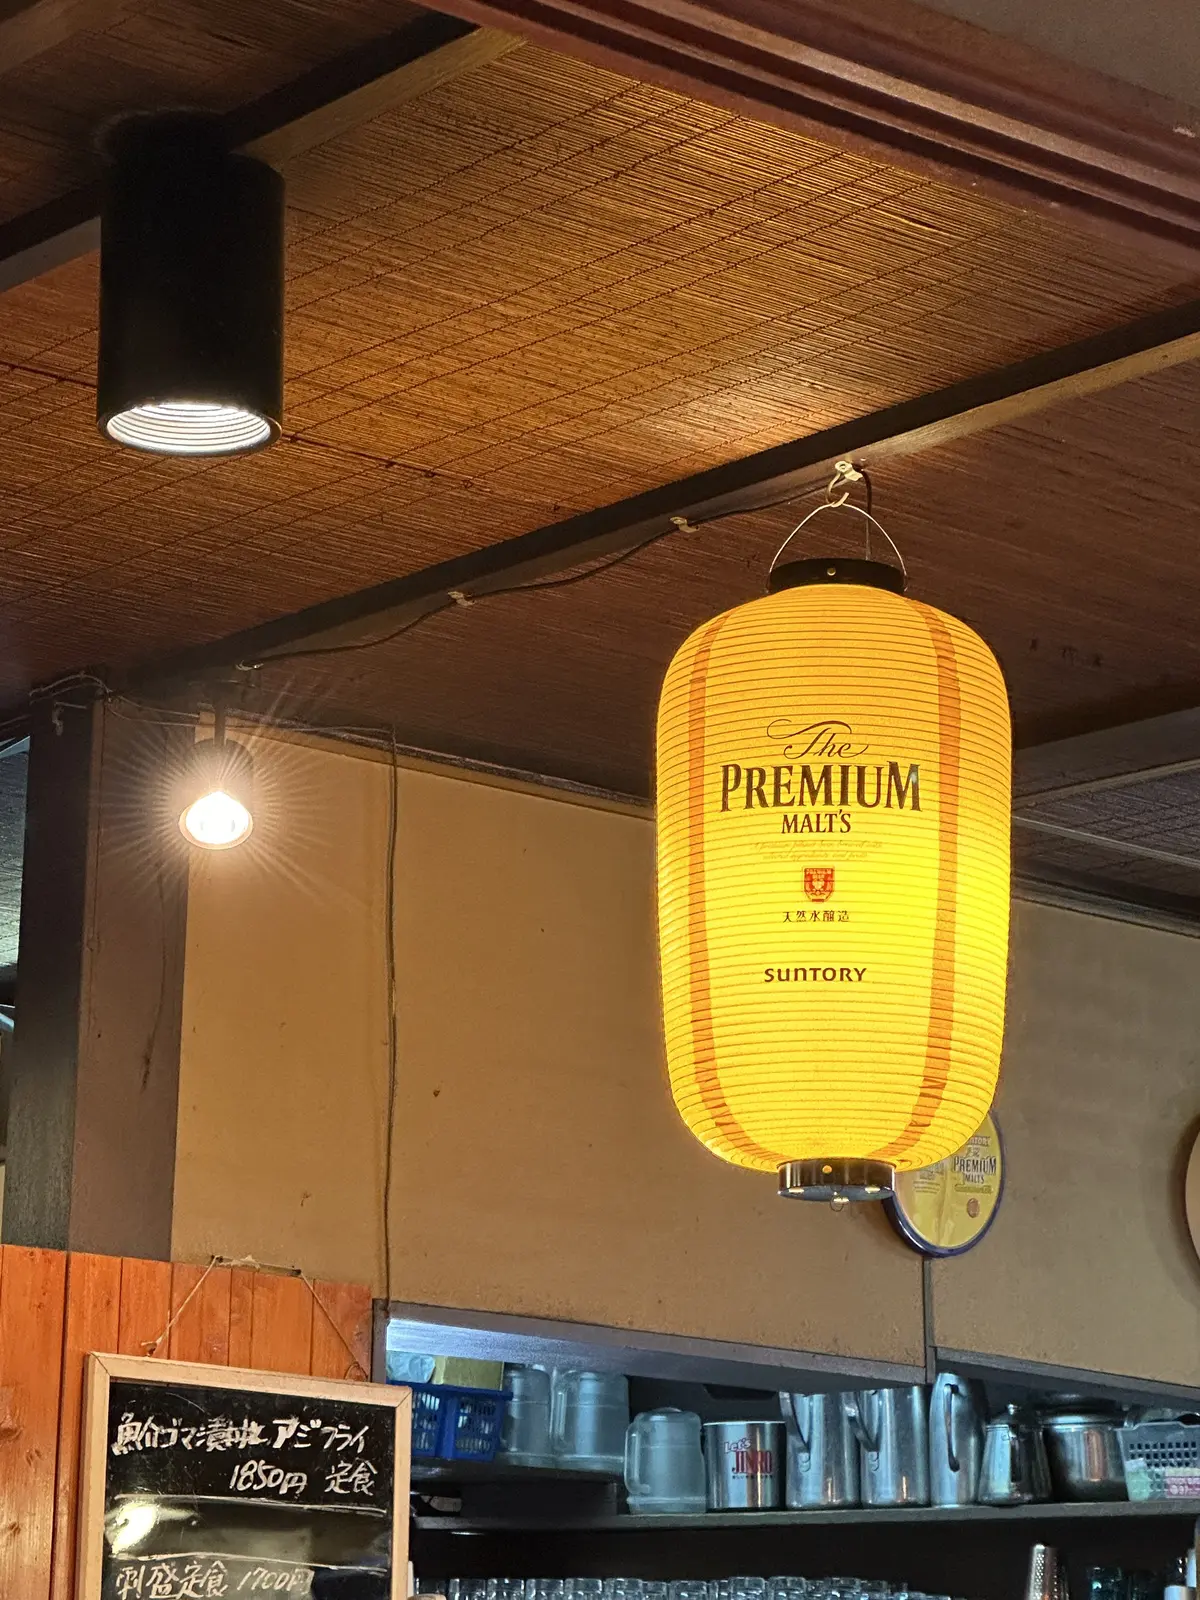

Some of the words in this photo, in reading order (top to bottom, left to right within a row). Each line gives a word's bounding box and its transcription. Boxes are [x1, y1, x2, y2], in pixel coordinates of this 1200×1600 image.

[767, 719, 869, 759] The
[720, 761, 922, 812] PREMIUM
[781, 809, 851, 834] MALT'S
[783, 910, 850, 923] 天然水醸造
[764, 967, 867, 982] SUNTORY
[953, 1156, 997, 1176] PREMIUM
[724, 1437, 751, 1454] Let's
[229, 1459, 308, 1495] 1850円
[324, 1457, 378, 1496] 定食
[236, 1566, 315, 1596] 1700円
